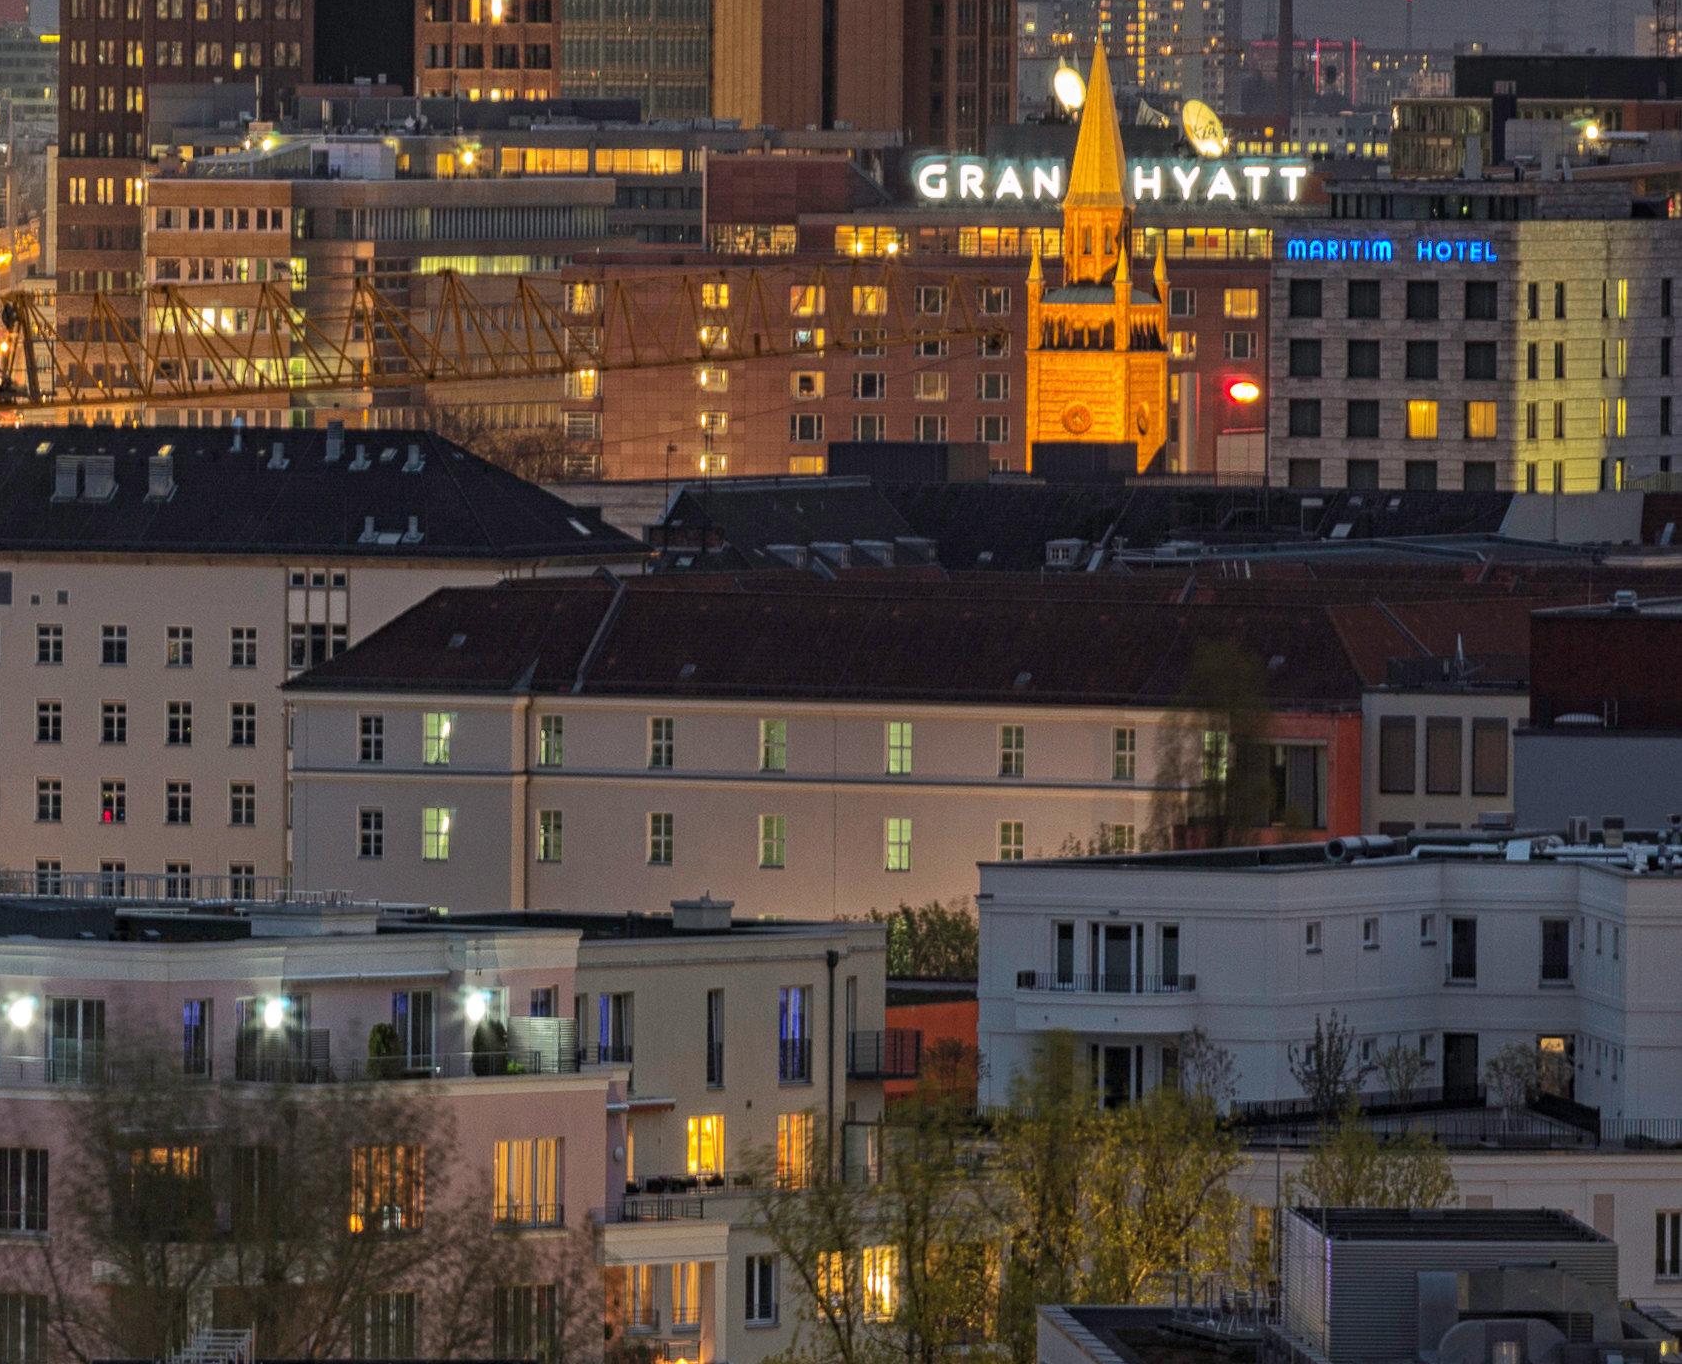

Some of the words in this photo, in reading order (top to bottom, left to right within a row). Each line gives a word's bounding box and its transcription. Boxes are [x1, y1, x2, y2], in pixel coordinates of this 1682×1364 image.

[918, 164, 1061, 200] GRAN
[1134, 165, 1307, 201] HYATT
[1287, 238, 1393, 262] MARITIM
[1416, 239, 1498, 263] HOTEL
